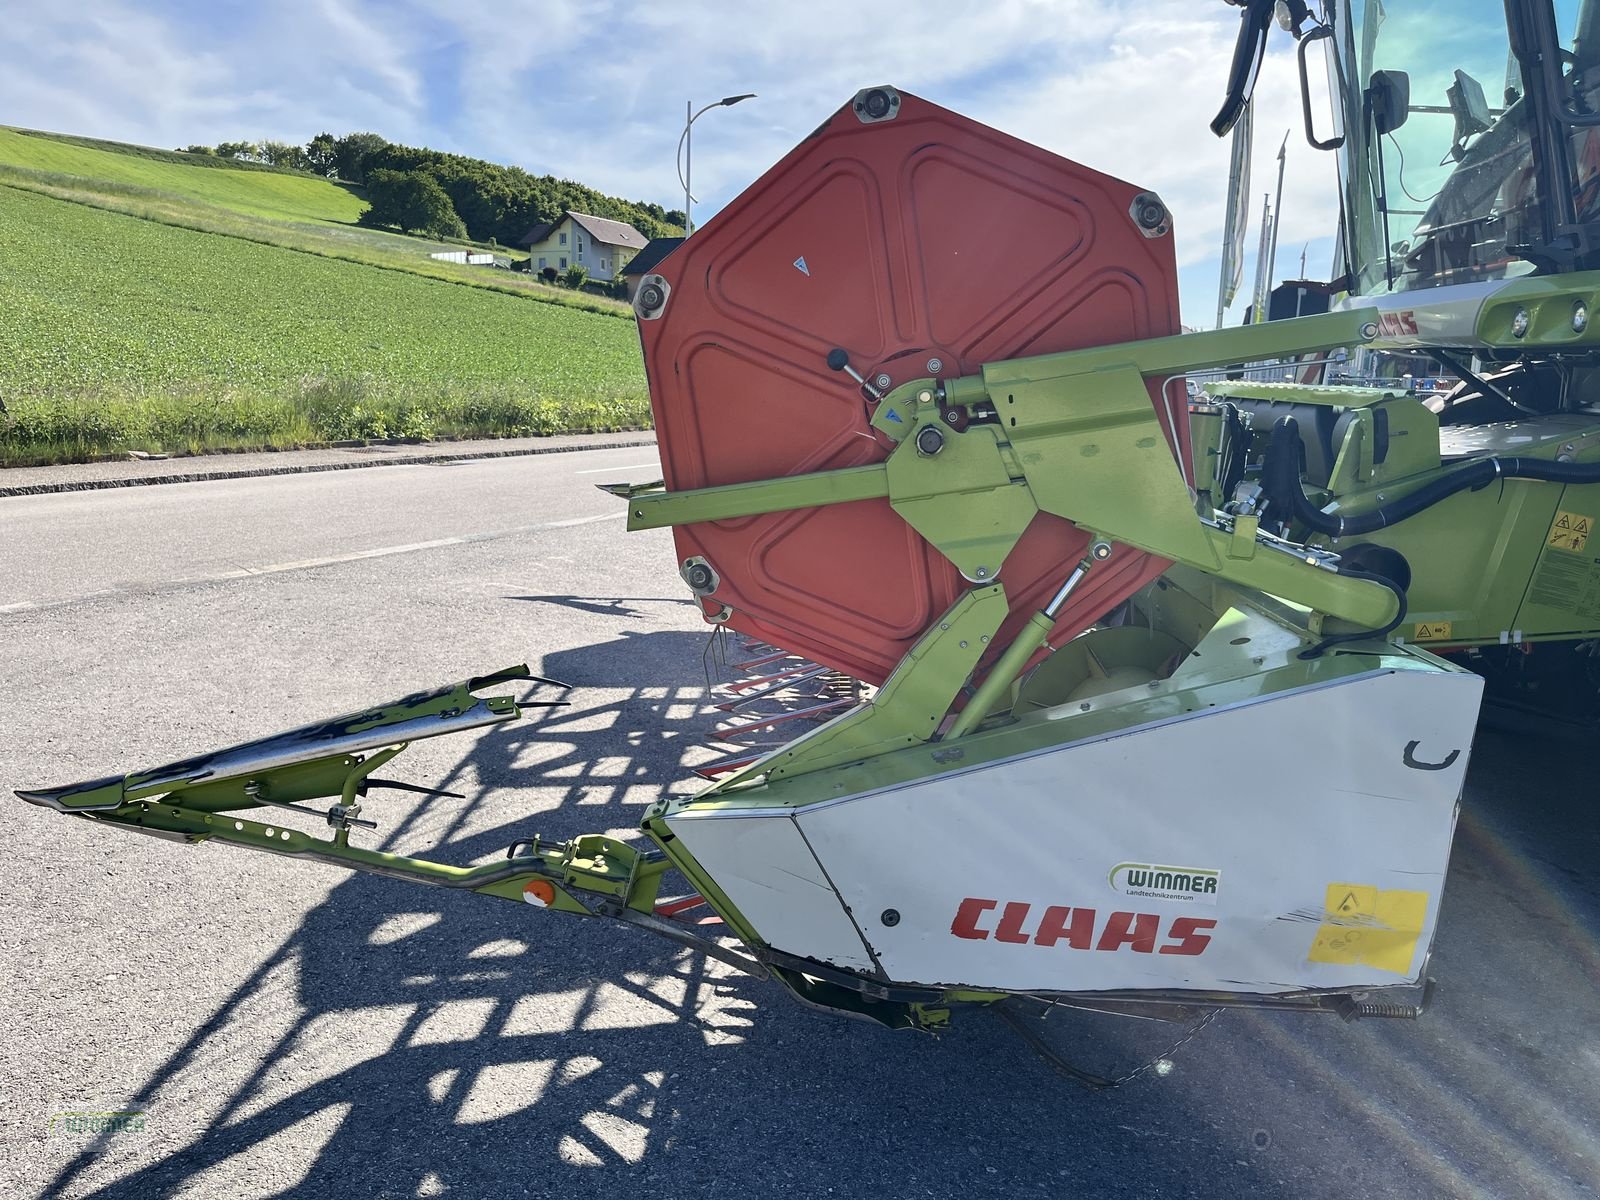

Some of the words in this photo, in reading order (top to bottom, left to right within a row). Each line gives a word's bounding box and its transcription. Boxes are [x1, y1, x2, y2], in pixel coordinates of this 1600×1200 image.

[1127, 869, 1218, 894] WIMMER
[1126, 889, 1194, 901] Landtechnikzentrum
[950, 897, 1218, 956] CLAAS
